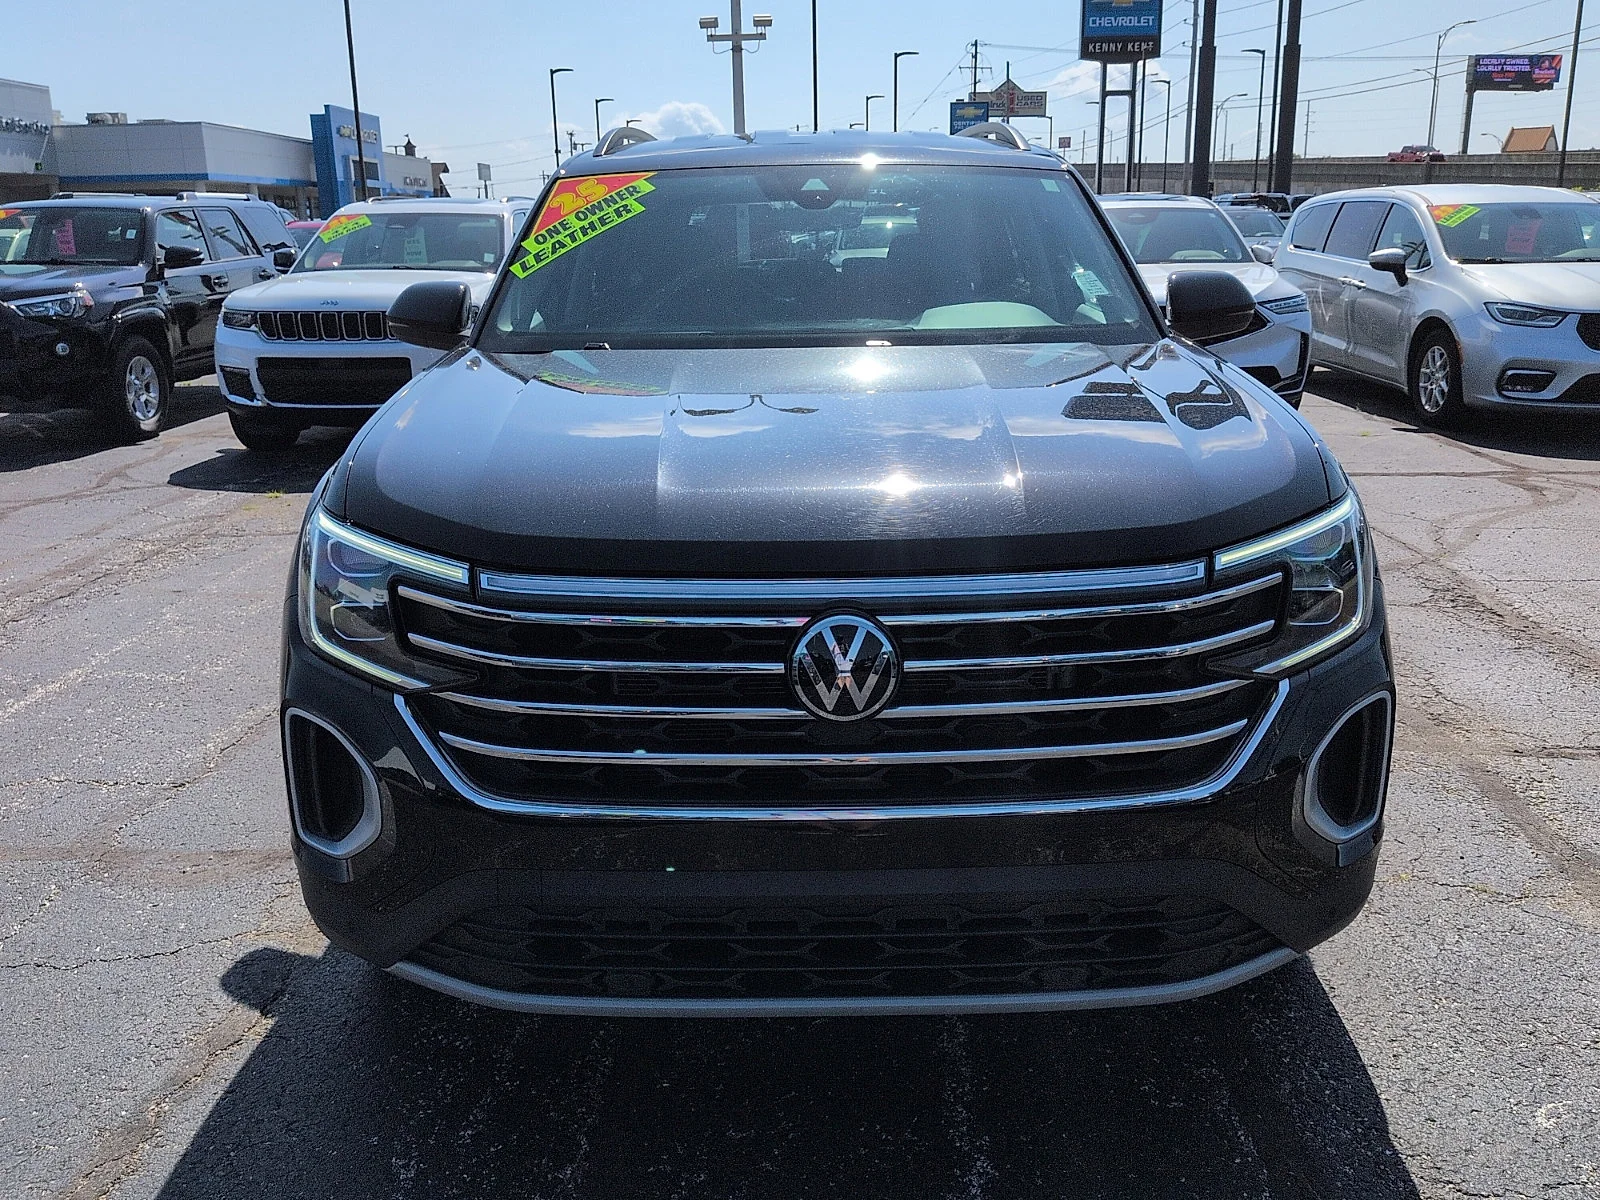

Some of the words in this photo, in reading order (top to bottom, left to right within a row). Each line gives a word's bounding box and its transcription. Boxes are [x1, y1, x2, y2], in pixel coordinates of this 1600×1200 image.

[1089, 15, 1154, 27] CHEVROLET
[1088, 42, 1122, 53] KENNY
[1127, 41, 1154, 52] KENT
[533, 219, 574, 245] ONE
[574, 185, 640, 222] OWNER
[549, 178, 608, 216] 25
[519, 203, 634, 273] LEATHER
